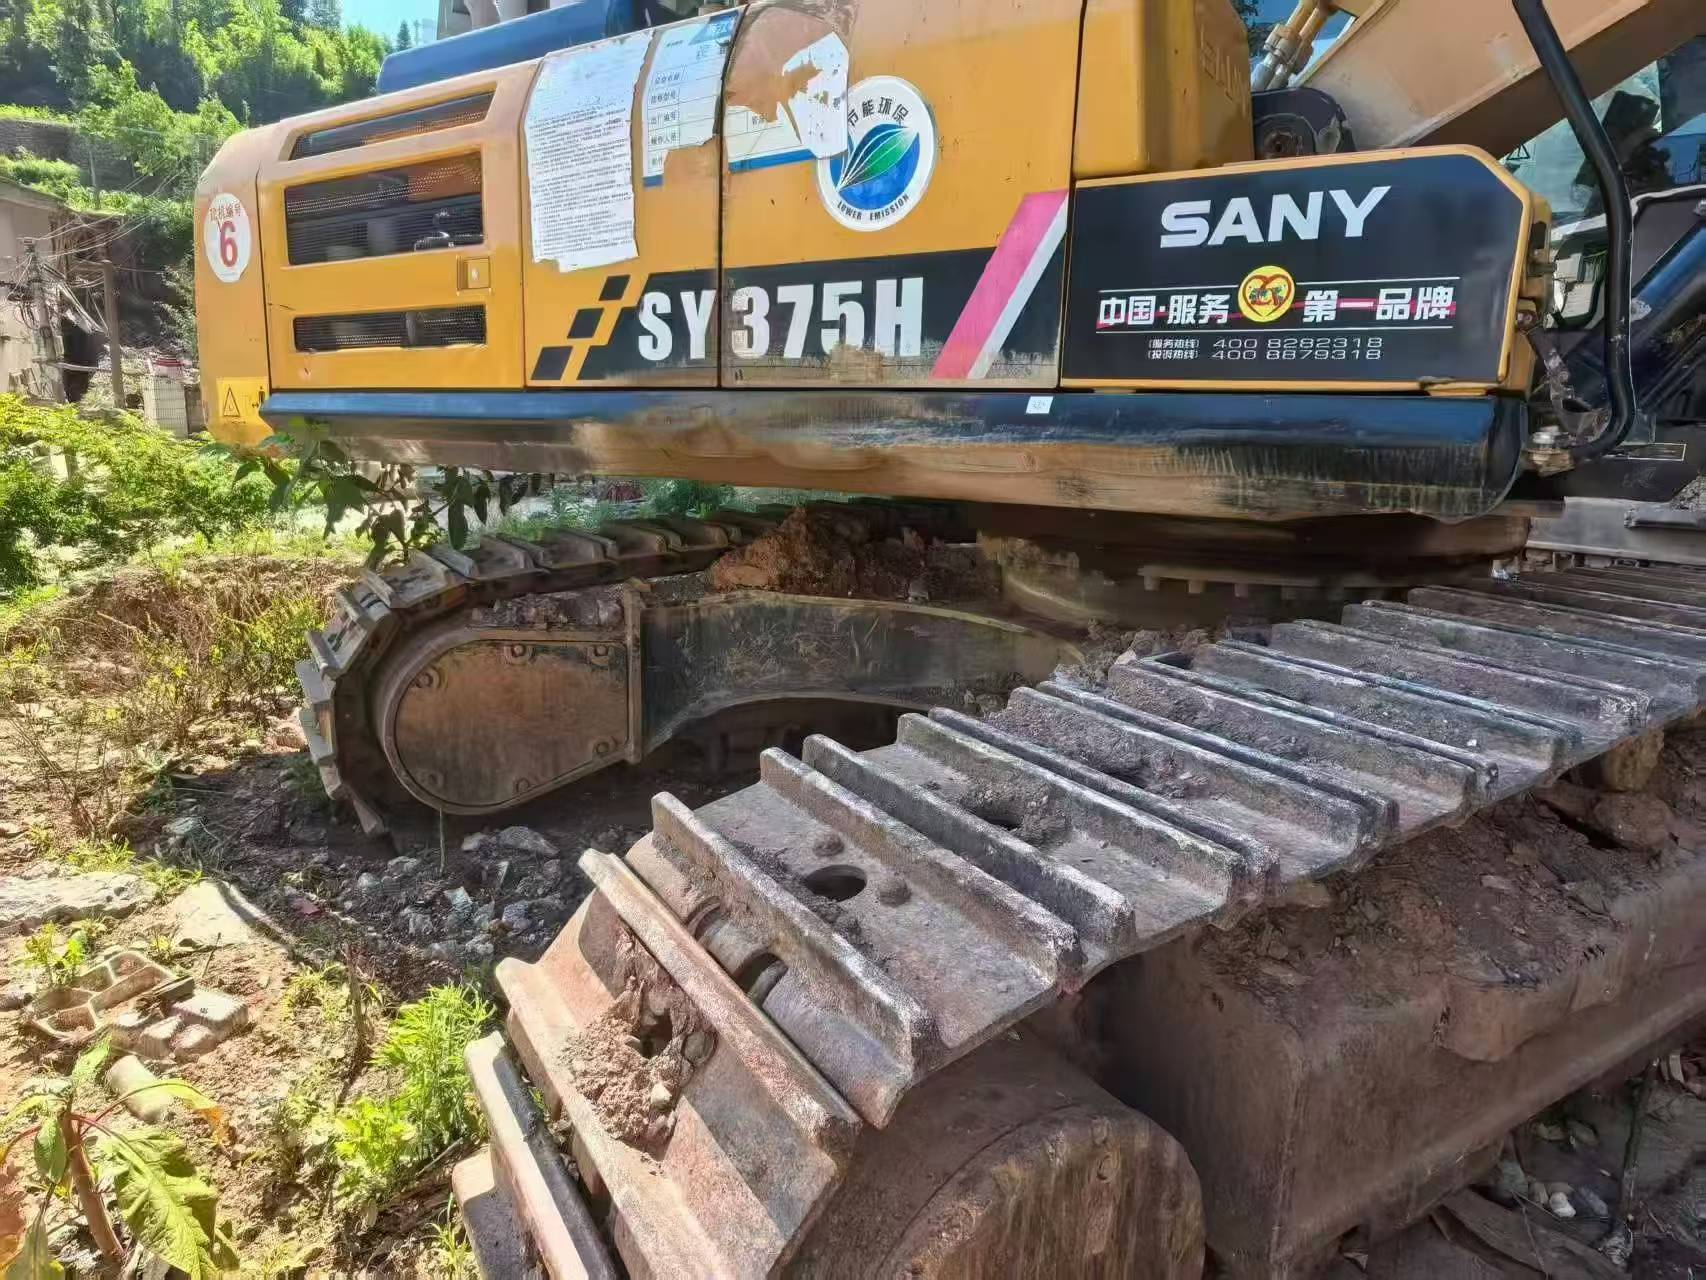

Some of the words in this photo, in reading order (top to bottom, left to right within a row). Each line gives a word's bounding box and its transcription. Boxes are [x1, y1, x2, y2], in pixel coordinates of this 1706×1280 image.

[837, 201, 862, 220] LOWER
[869, 193, 909, 221] EMISSION
[1160, 186, 1392, 248] SANY
[220, 221, 238, 267] 6
[1099, 294, 1230, 326] 中国·服务
[1302, 286, 1454, 322] 第一品牌
[1211, 350, 1257, 360] 400
[1266, 349, 1381, 360] 8879318
[1213, 338, 1258, 349] 400
[1267, 337, 1383, 349] 8282318
